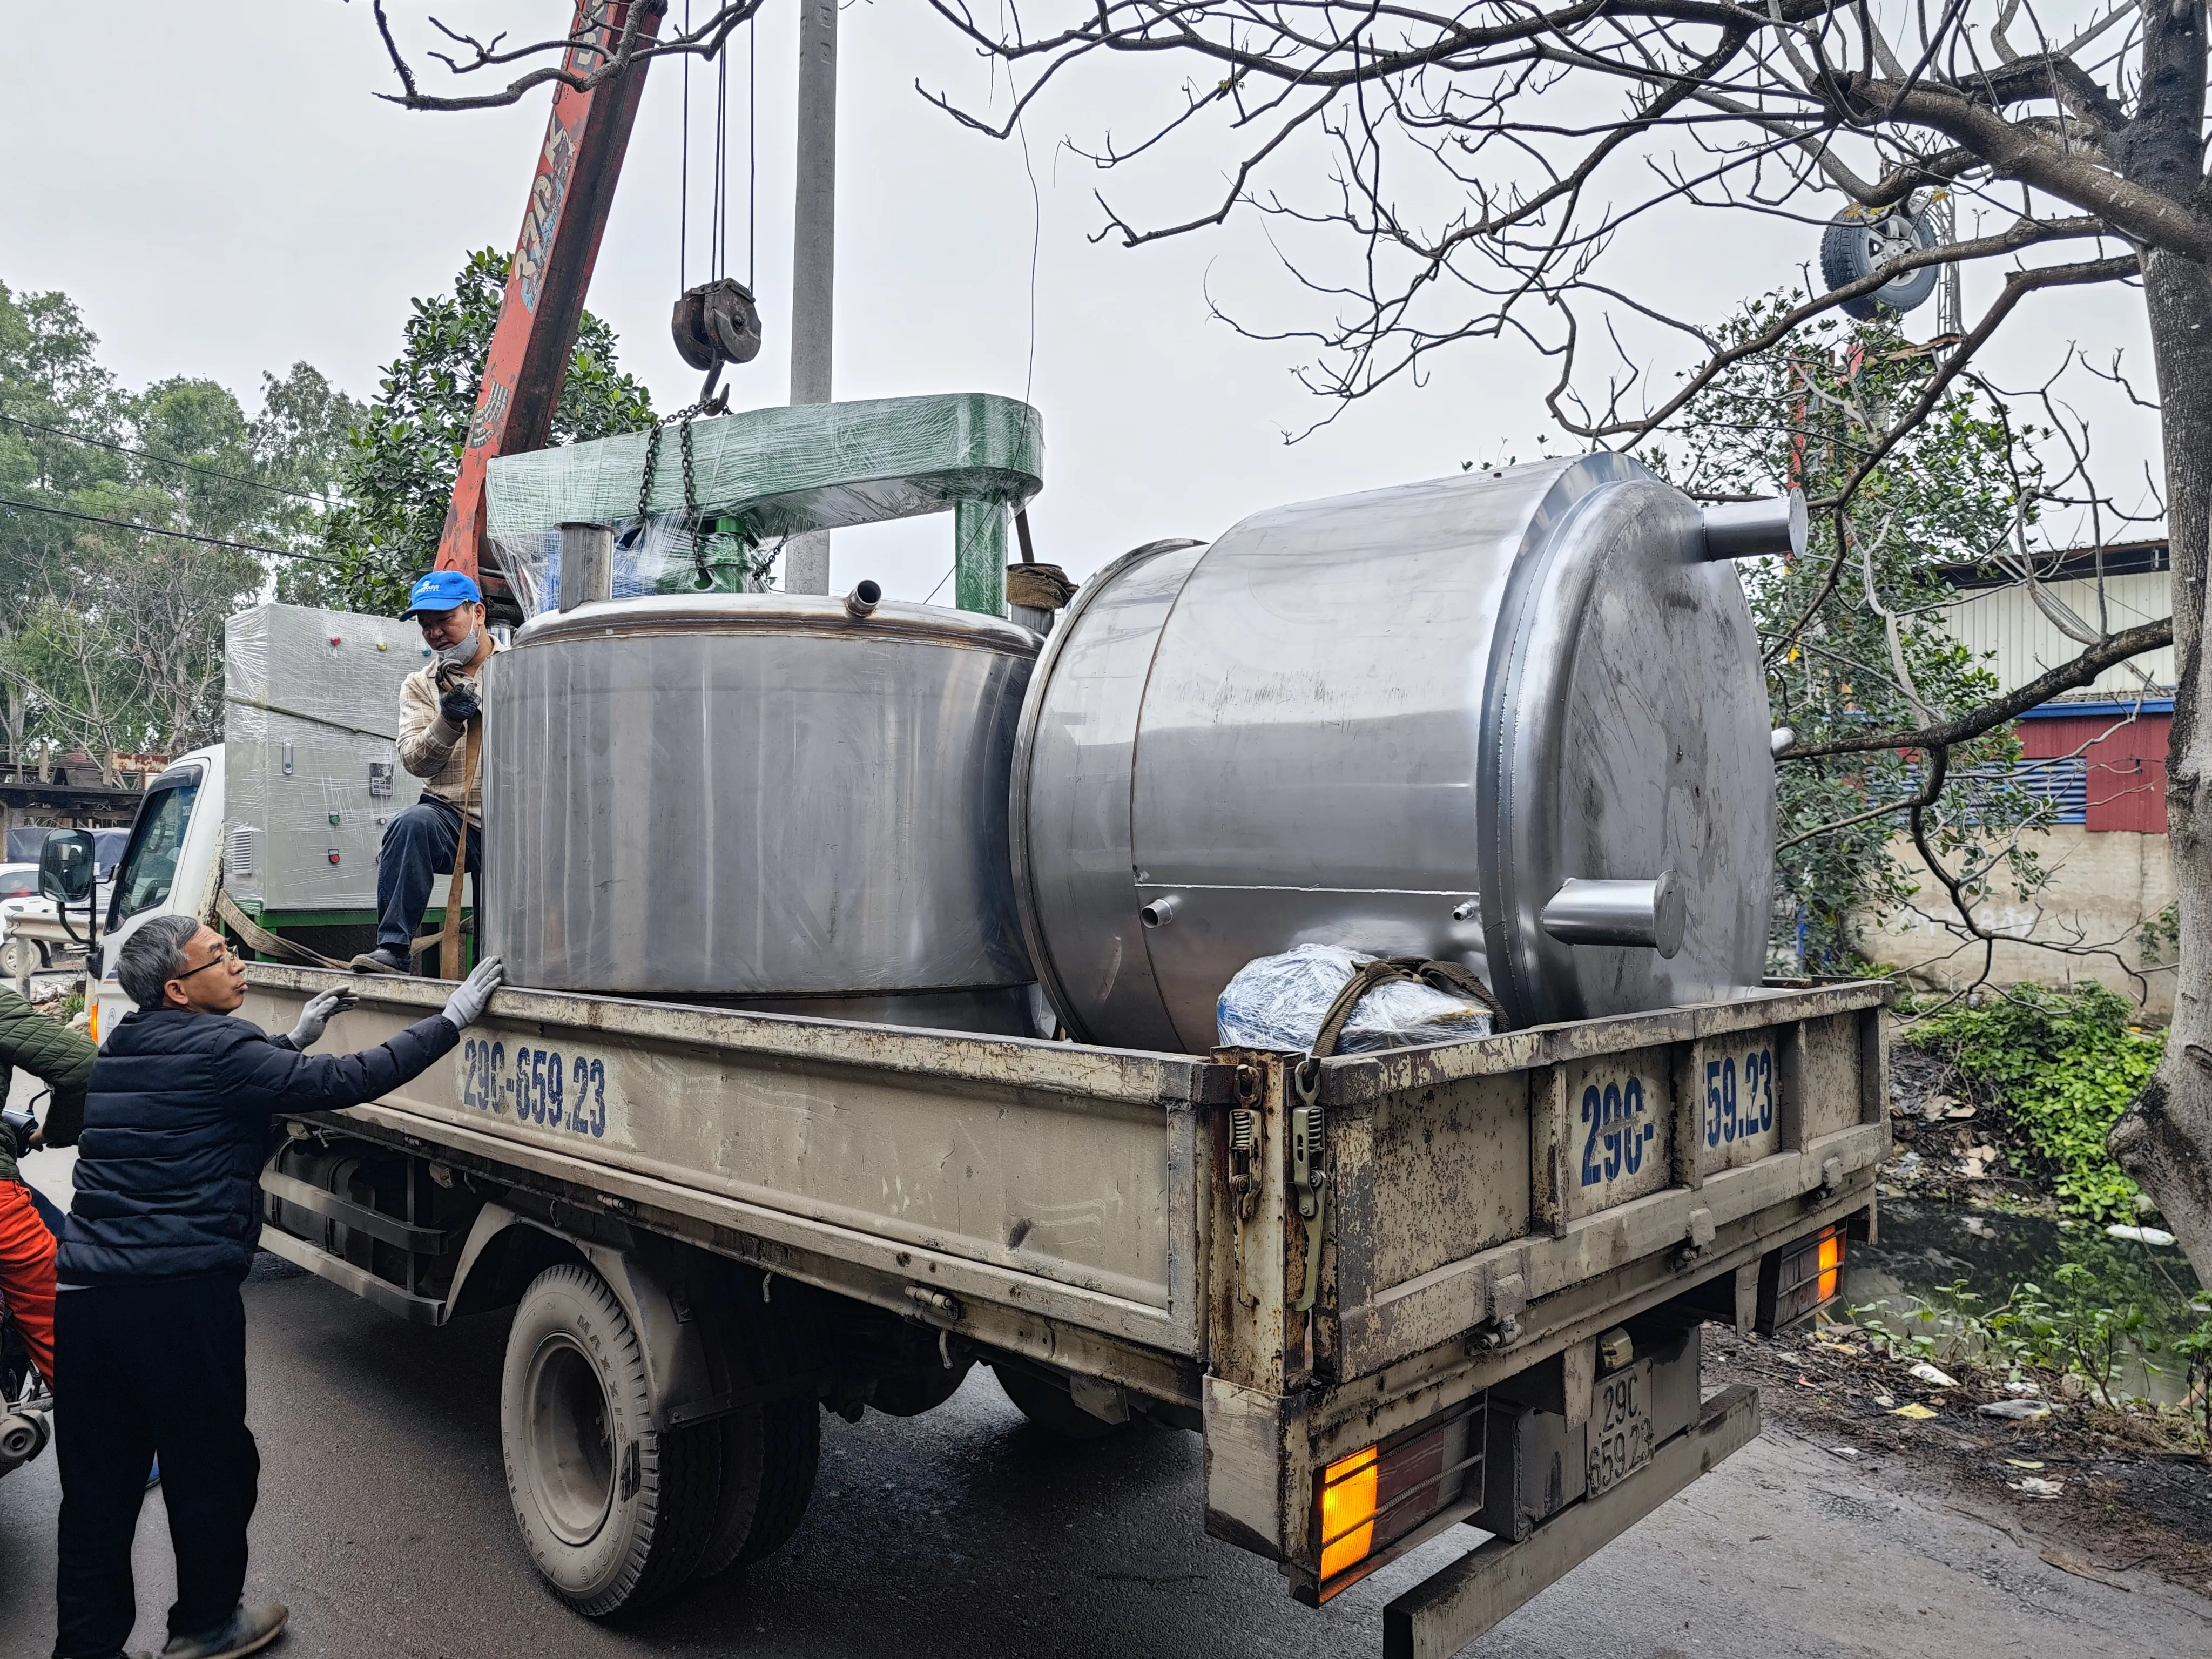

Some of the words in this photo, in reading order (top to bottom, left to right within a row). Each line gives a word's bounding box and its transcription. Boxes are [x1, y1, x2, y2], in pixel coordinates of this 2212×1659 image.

[1702, 1049, 1772, 1148] 59.23
[576, 1314, 627, 1444] MAXXIS
[1602, 1371, 1638, 1433] 29C
